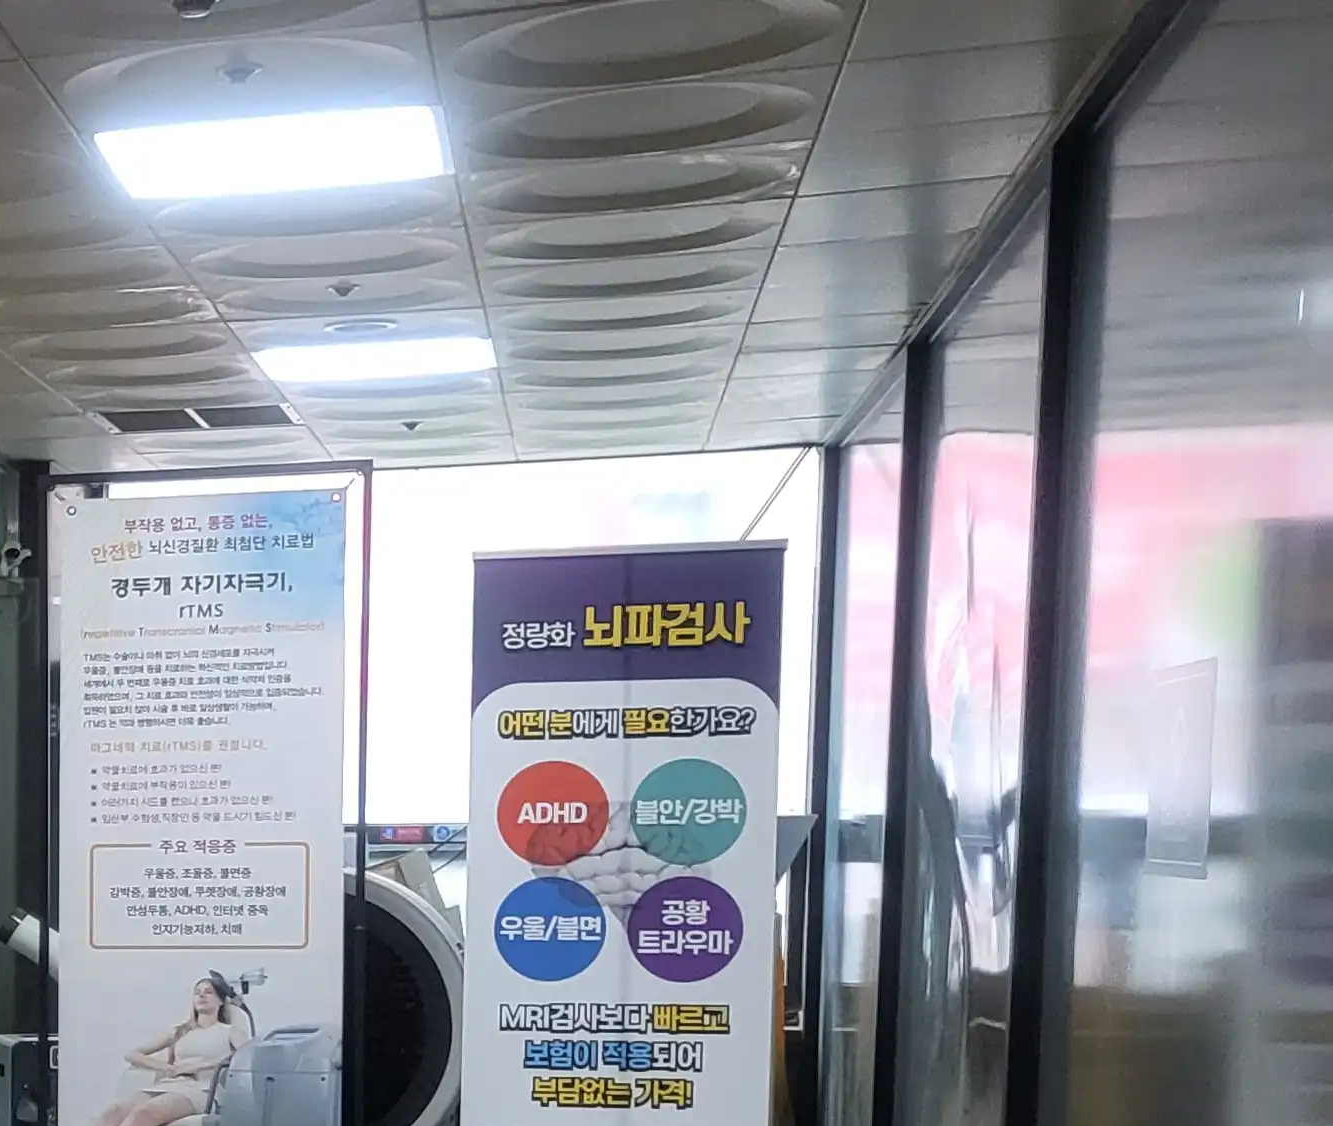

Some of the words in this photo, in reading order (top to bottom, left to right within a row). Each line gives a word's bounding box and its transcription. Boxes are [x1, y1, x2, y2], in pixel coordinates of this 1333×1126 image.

[91, 540, 142, 563] 안전한
[149, 537, 218, 555] 뇌신경질환
[224, 535, 265, 552] 최첨단
[271, 532, 314, 549] 치료법
[111, 575, 172, 598] 경두개
[180, 572, 293, 595] 자기자극기,
[179, 604, 224, 618] rTMS
[502, 620, 576, 650] 정량화
[583, 601, 751, 648] 뇌파검사
[499, 710, 545, 739] 어떤
[549, 709, 619, 738] 분에게
[622, 706, 757, 738] 필요한가요?
[517, 802, 588, 825] ADHD
[635, 798, 743, 826] 불안/강박
[159, 840, 188, 854] 주요
[193, 839, 236, 854] 적응증
[661, 900, 711, 926] 공황
[500, 916, 602, 942] 우울/불면
[637, 930, 734, 955] 트라우마
[500, 1004, 648, 1033] MRI검사보다
[652, 1005, 730, 1035] 빠르고
[524, 1040, 598, 1070] 보험이
[603, 1040, 703, 1072] 적용되어
[532, 1076, 631, 1108] 부담없는
[635, 1078, 693, 1109] 가격!
